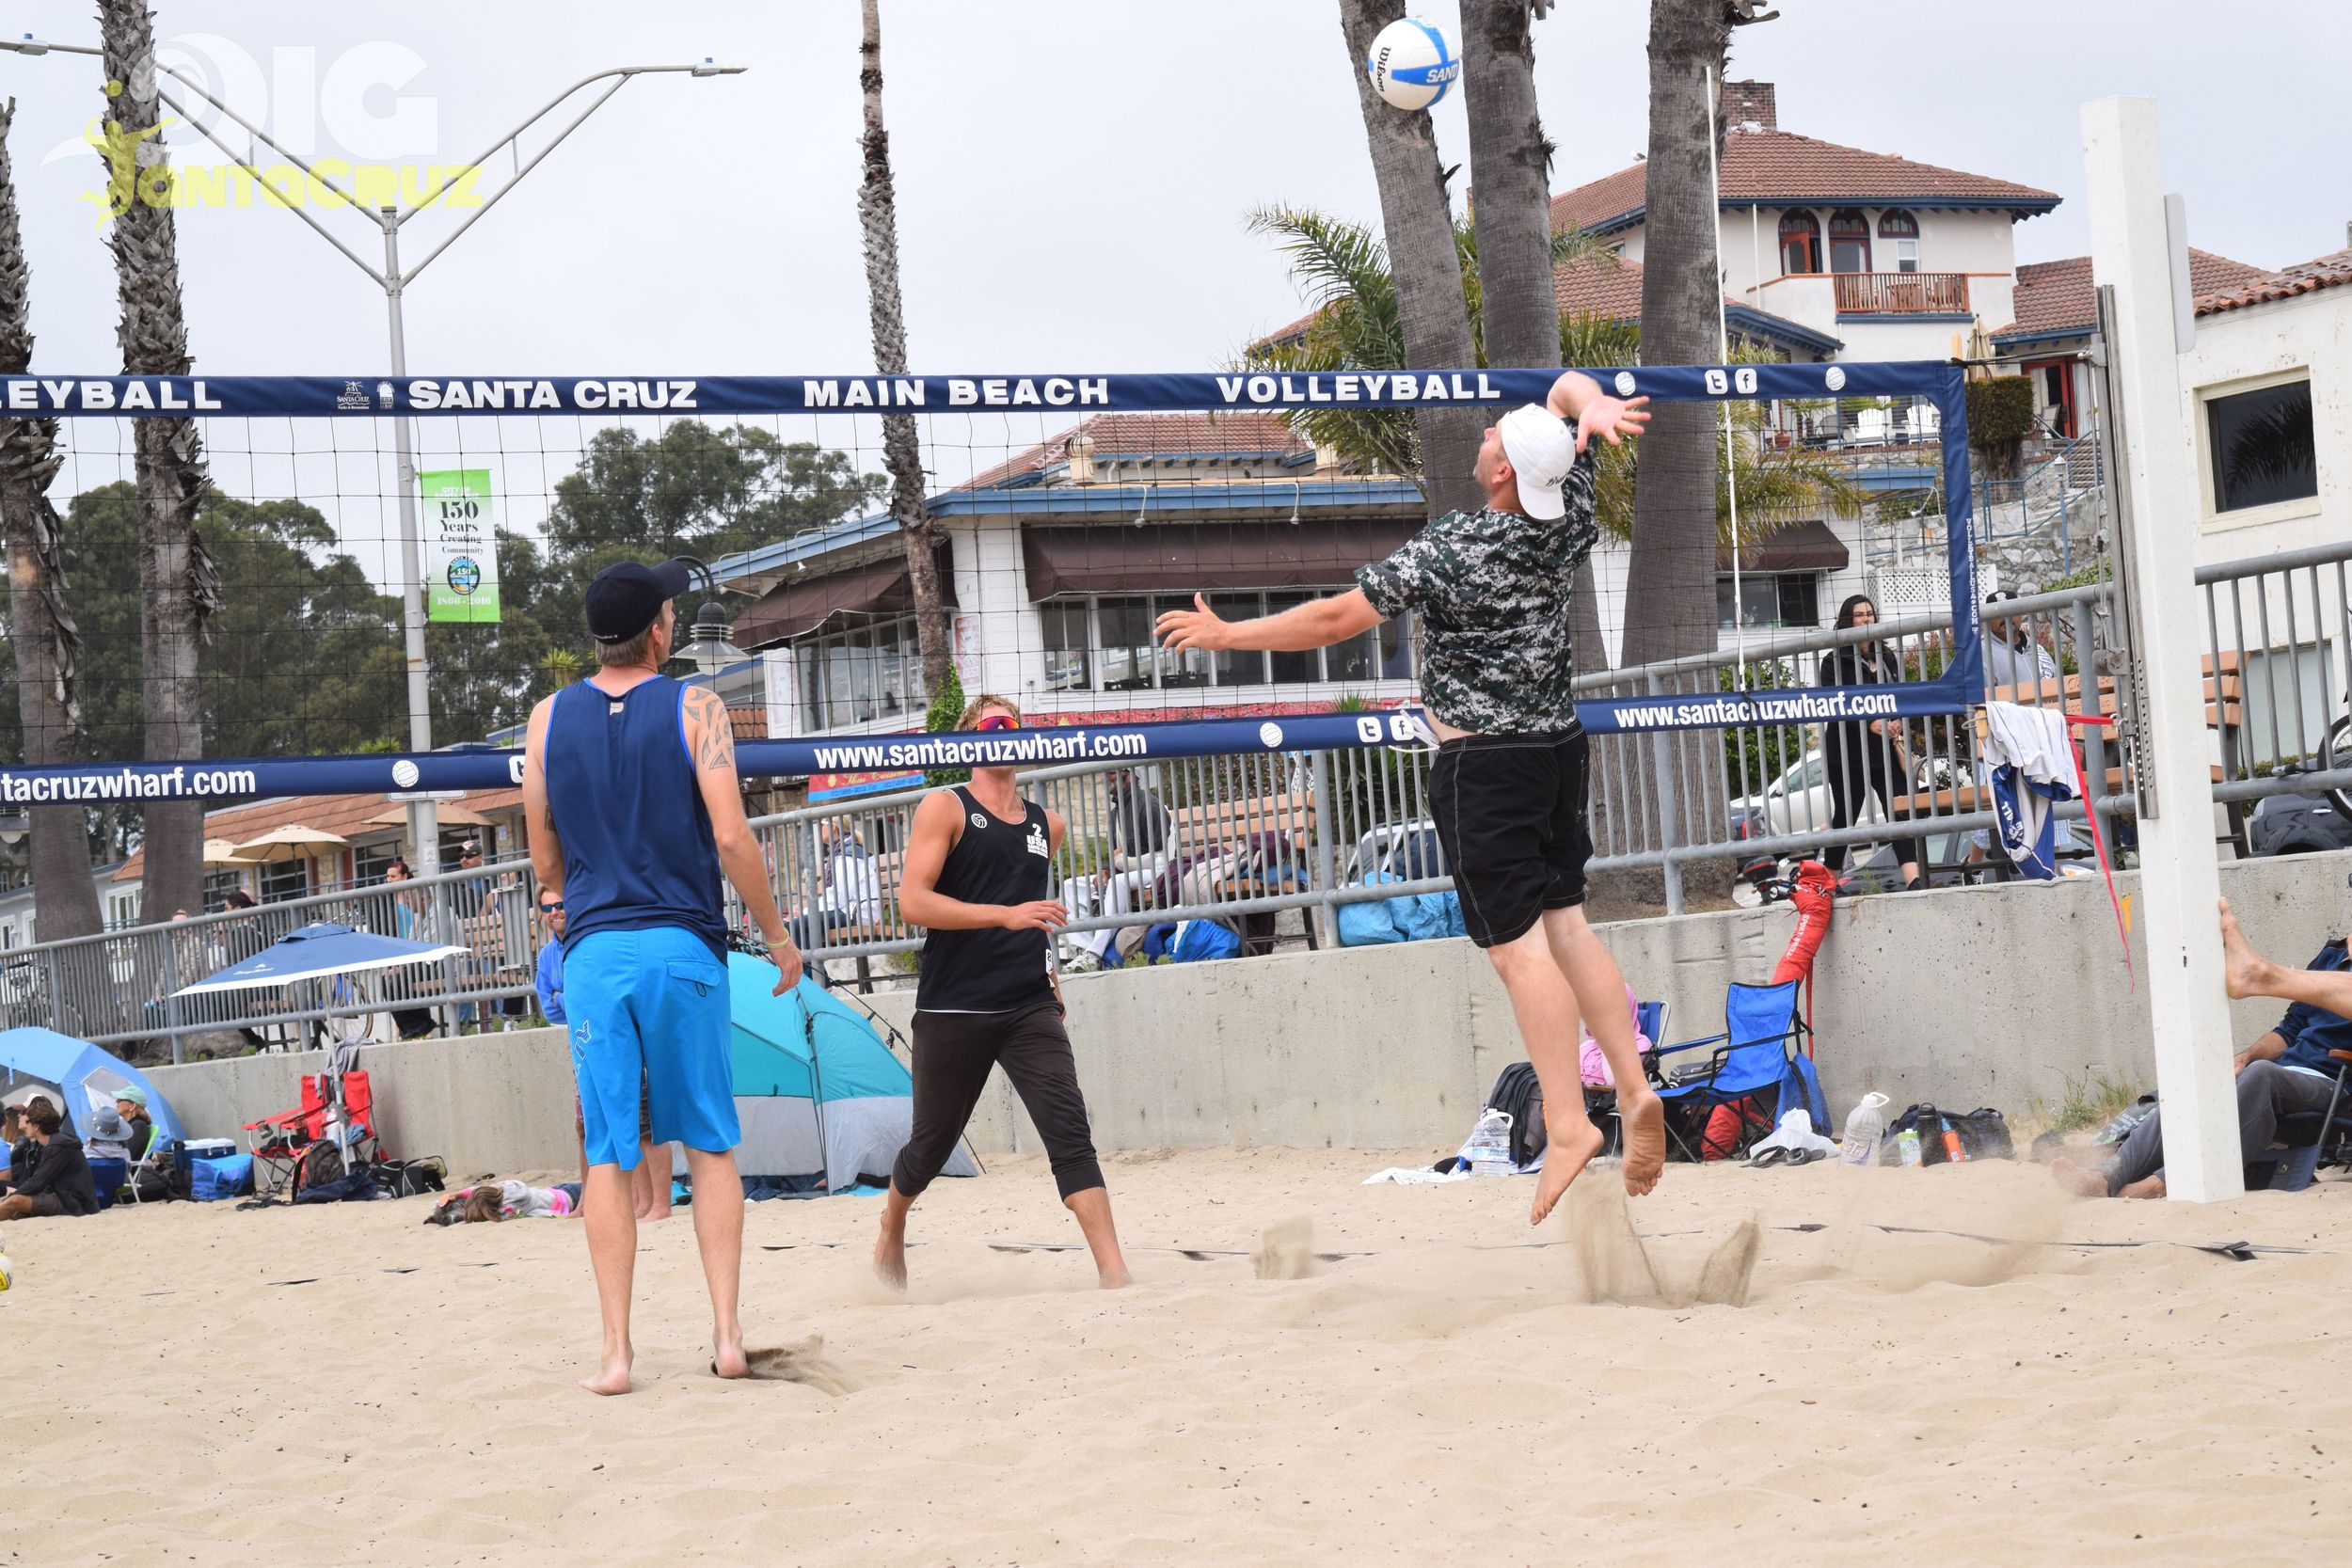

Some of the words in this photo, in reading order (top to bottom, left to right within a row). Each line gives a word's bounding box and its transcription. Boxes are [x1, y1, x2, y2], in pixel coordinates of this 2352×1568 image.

[1377, 47, 1391, 92] Wilson
[0, 380, 221, 409] EYBALL
[409, 380, 562, 408] SANTA
[574, 380, 697, 408] CRUZ
[803, 379, 925, 406] MAIN
[948, 377, 1108, 406] BEACH
[1215, 373, 1501, 403] VOLLEYBALL
[439, 500, 479, 519] 150
[440, 519, 478, 532] Years
[440, 533, 482, 544] Creating
[442, 546, 484, 556] Community
[1613, 690, 1898, 728] www.santacruzwharf.com
[814, 731, 1147, 769] www.santacruzwharf.com
[0, 767, 256, 801] tacruzwharf.com
[1026, 835, 1048, 850] USA
[1032, 823, 1042, 837] 2
